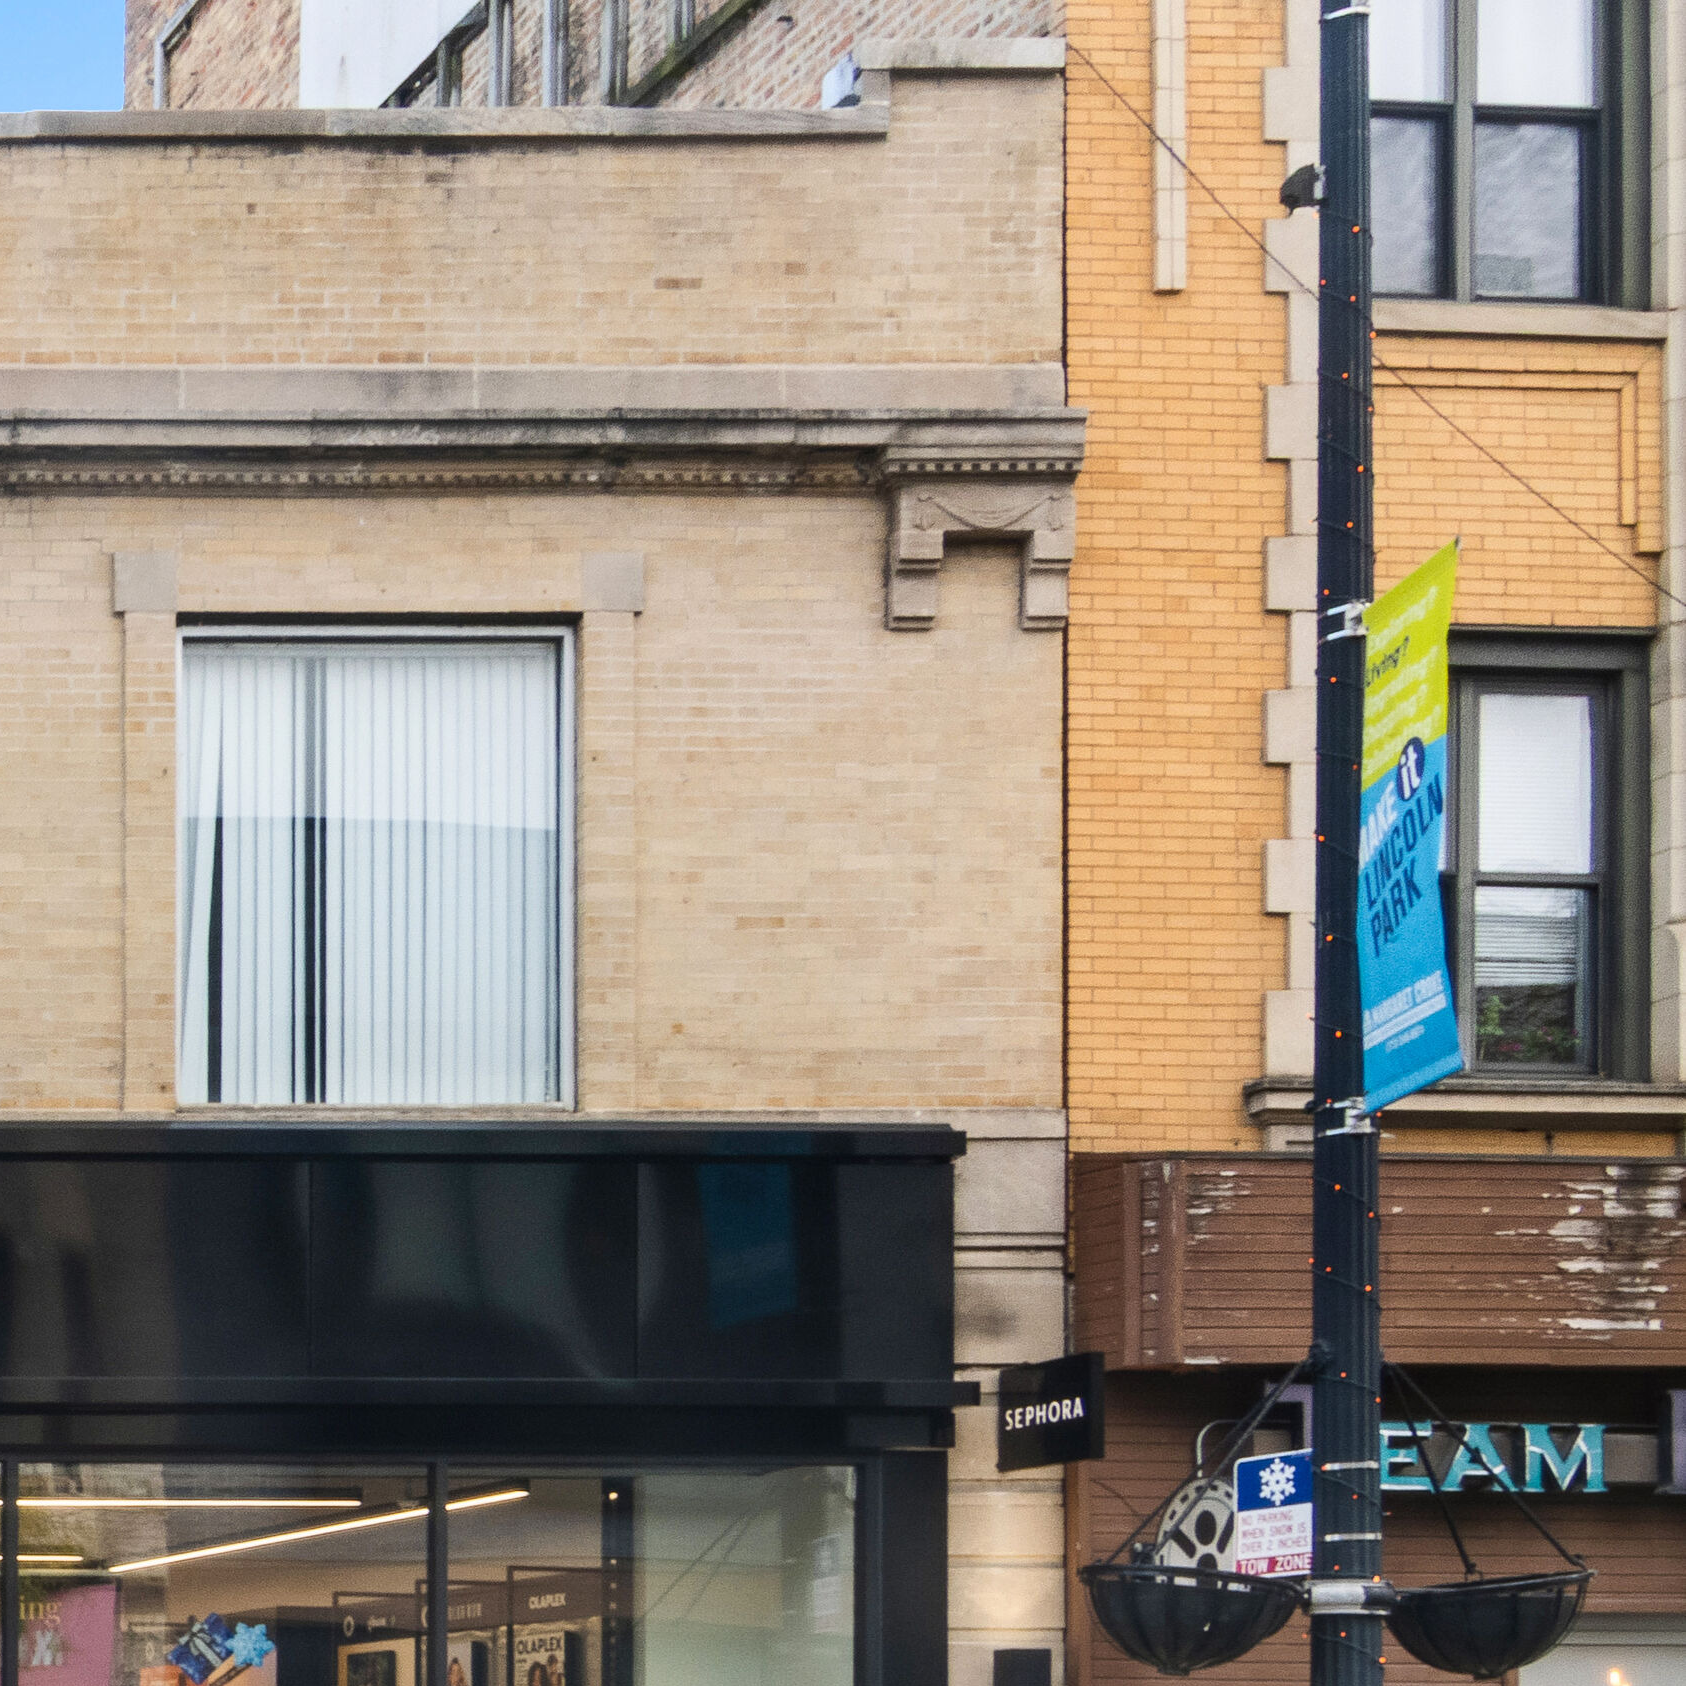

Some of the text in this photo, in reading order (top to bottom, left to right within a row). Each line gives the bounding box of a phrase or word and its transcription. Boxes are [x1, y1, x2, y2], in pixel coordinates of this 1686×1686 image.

[1400, 744, 1421, 800] it
[1365, 773, 1443, 910] LINCOLN
[1371, 856, 1423, 957] PARK
[1005, 1397, 1084, 1431] SEPHORA
[1380, 1422, 1608, 1494] EAM
[1258, 1510, 1294, 1523] PARKING
[1270, 1525, 1293, 1536] SNOW
[1240, 1553, 1312, 1575] TOW ZONE
[528, 1593, 566, 1609] OLAPLEX
[515, 1636, 564, 1655] OLAPLEX
